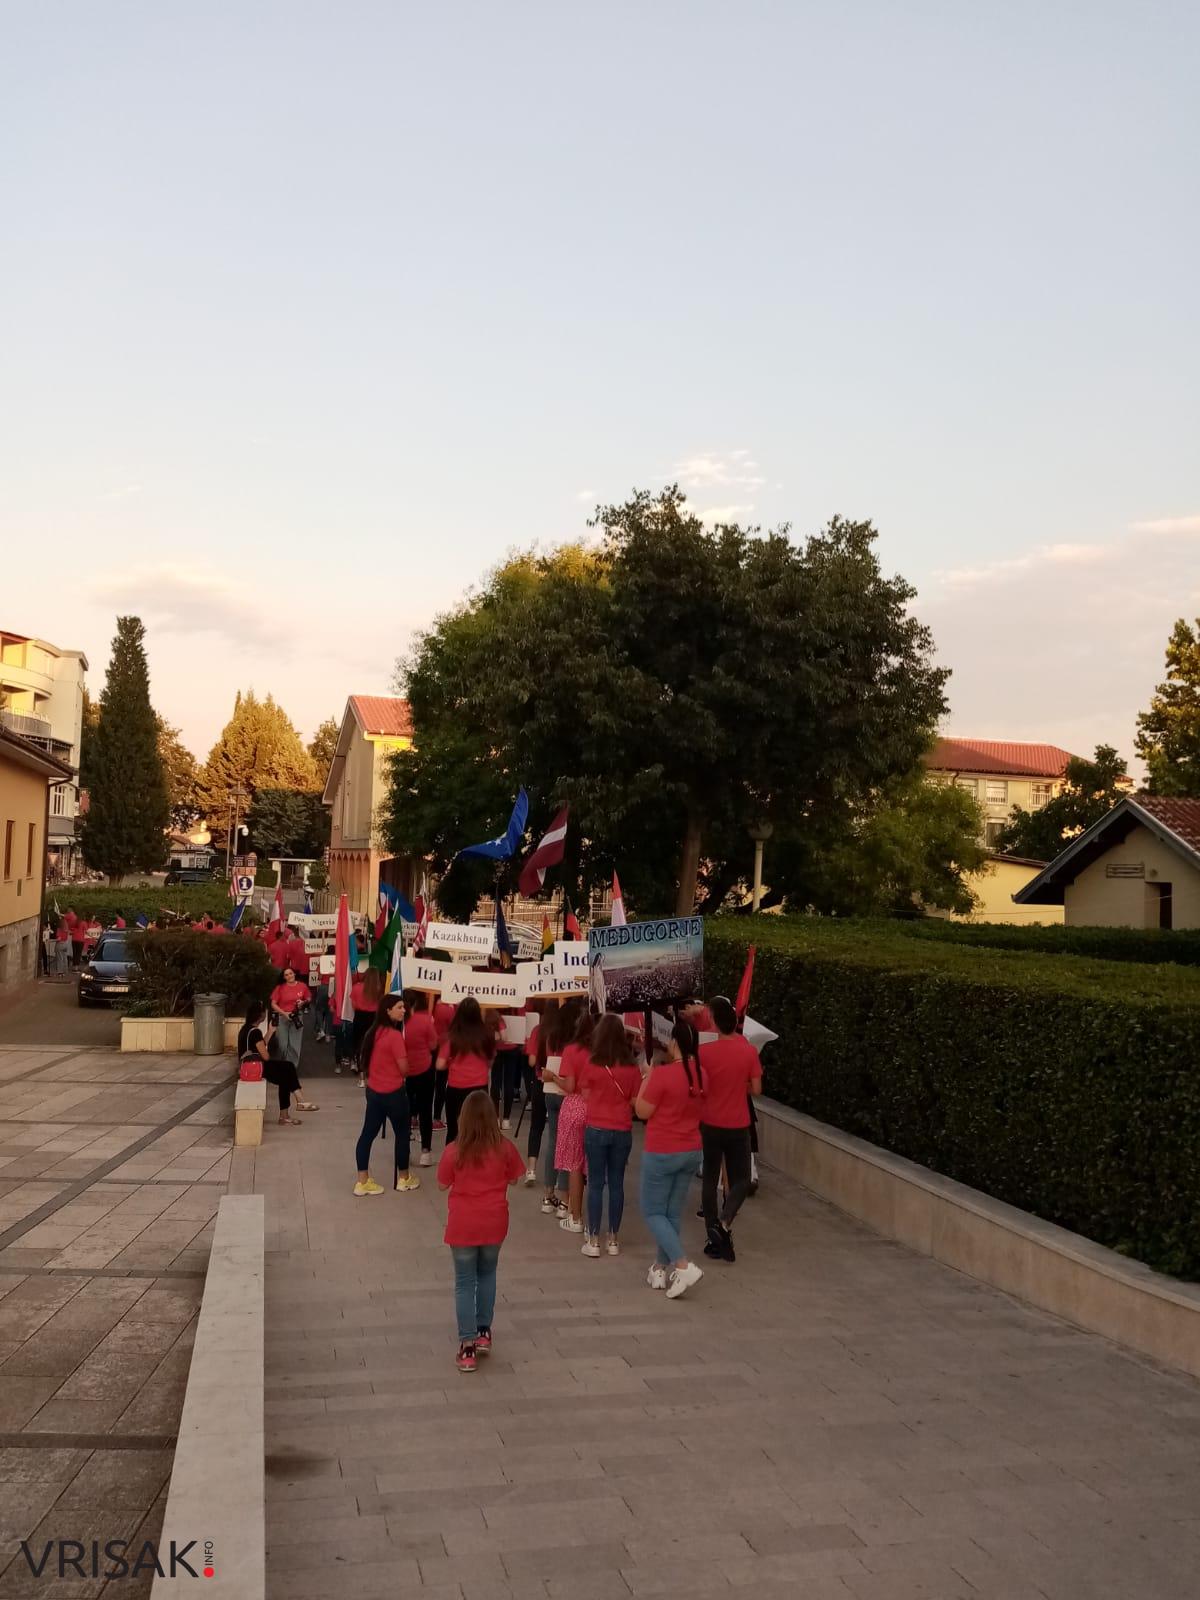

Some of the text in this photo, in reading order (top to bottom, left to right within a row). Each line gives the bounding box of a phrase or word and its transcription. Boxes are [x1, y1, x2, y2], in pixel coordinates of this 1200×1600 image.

[432, 930, 489, 945] Kazakhstan
[563, 951, 589, 966] Ind
[417, 966, 442, 982] Ital
[536, 963, 554, 975] Isl
[451, 983, 516, 997] Argentina
[529, 979, 543, 992] of
